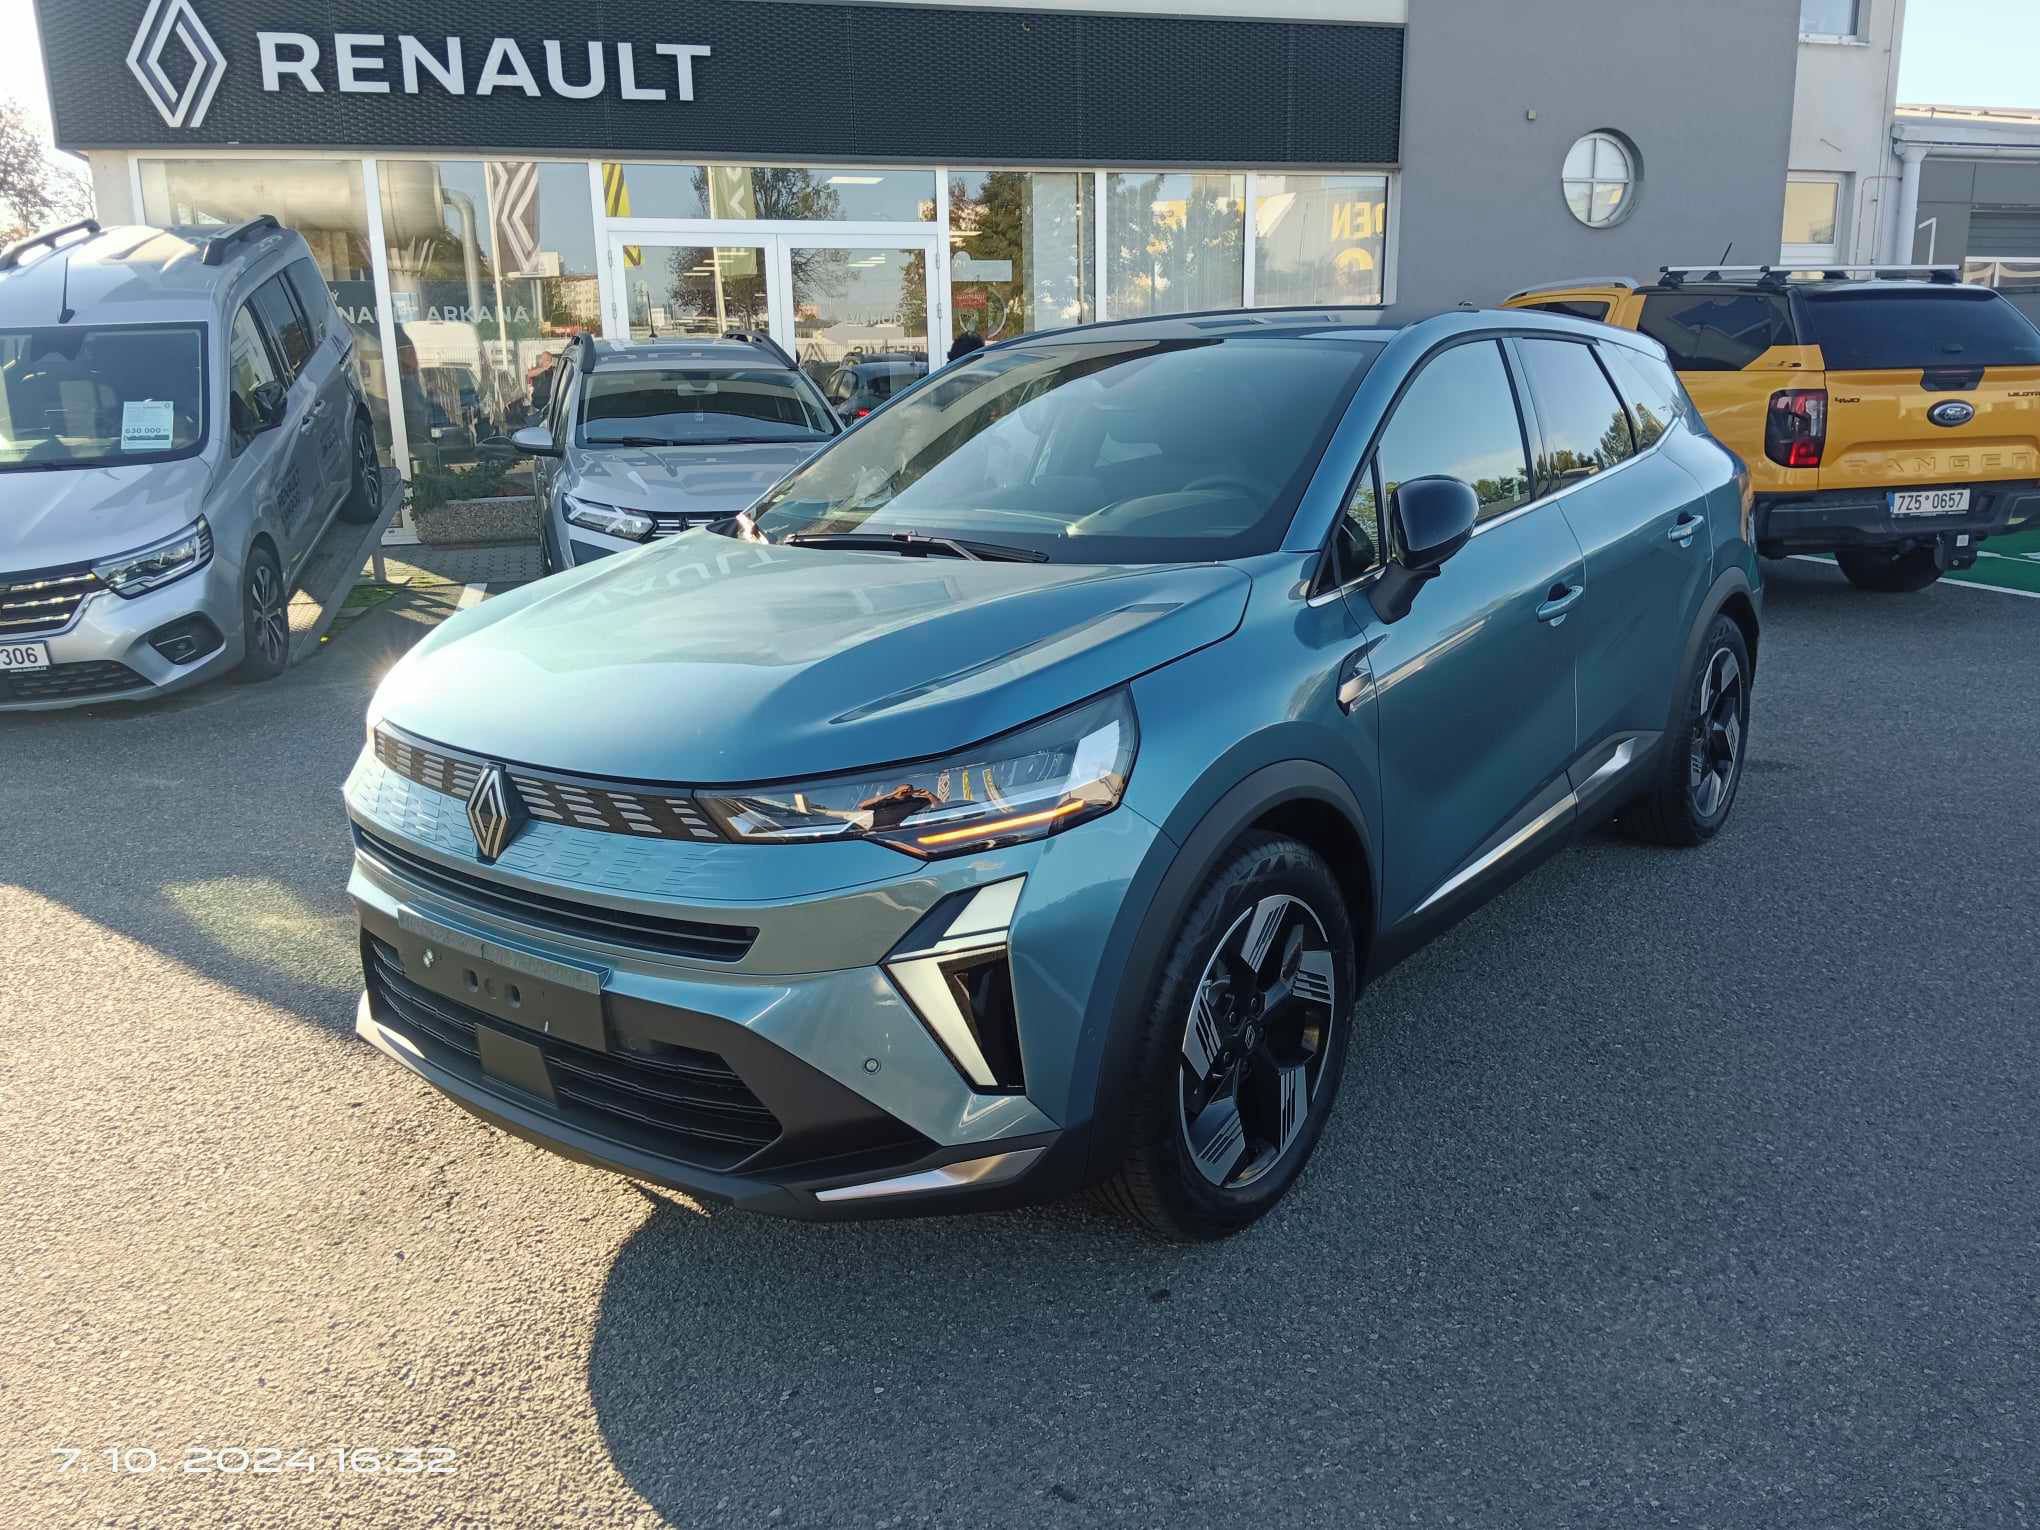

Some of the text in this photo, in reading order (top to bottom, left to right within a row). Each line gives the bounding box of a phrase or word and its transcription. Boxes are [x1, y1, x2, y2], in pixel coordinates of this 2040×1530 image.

[256, 31, 711, 101] RENAULT
[1897, 492, 1964, 511] 7Z5 0657
[0, 647, 38, 665] 306
